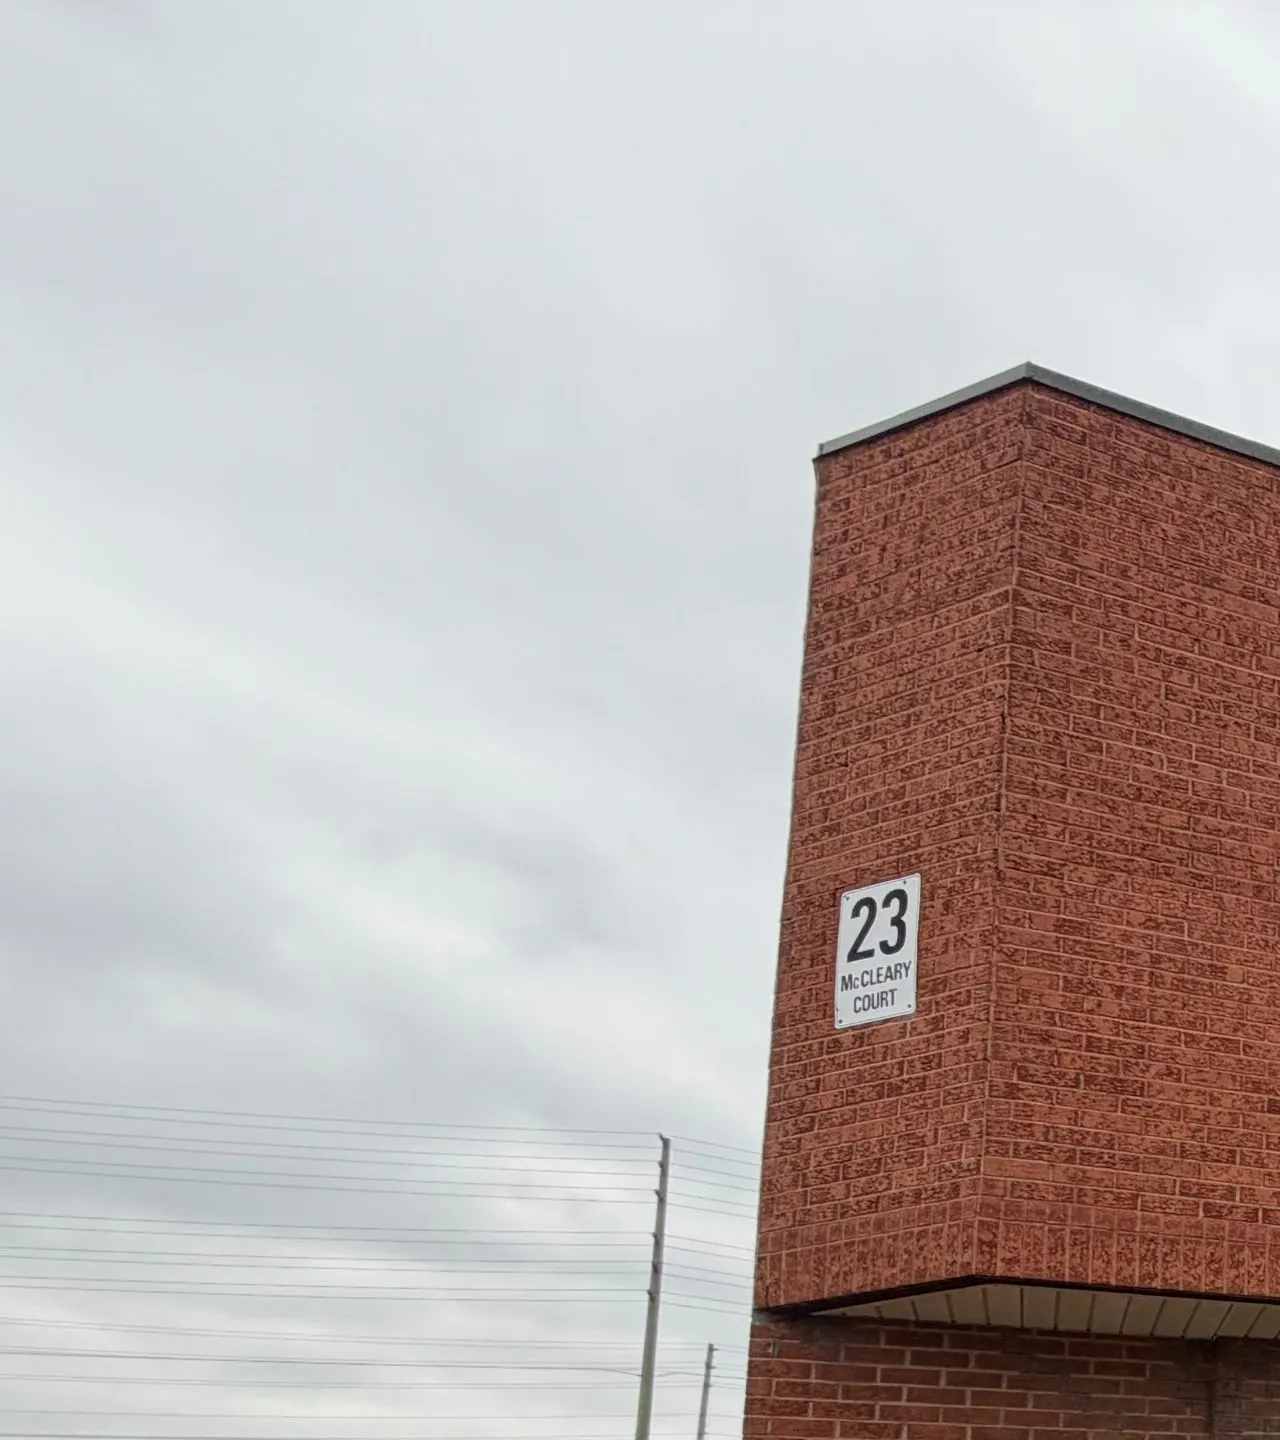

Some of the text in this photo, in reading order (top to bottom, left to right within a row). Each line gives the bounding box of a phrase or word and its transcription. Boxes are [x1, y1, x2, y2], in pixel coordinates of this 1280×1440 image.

[847, 888, 909, 963] 23
[840, 960, 912, 993] McCLEARY
[853, 988, 898, 1014] COURT
